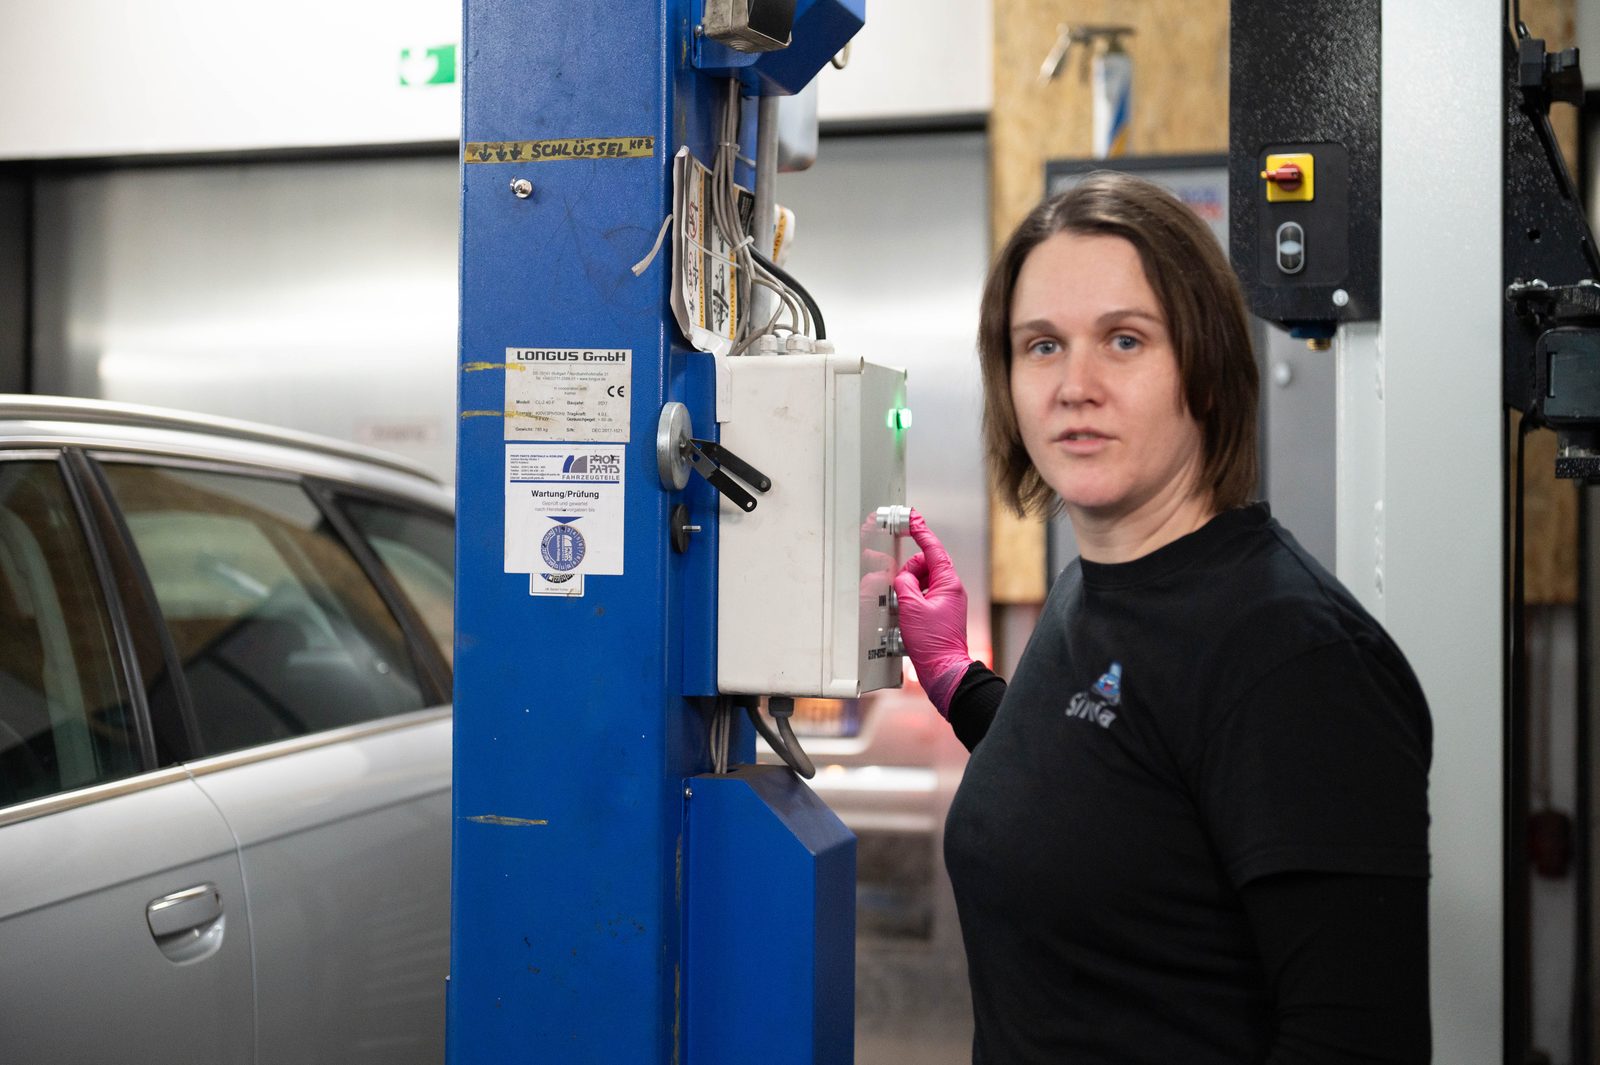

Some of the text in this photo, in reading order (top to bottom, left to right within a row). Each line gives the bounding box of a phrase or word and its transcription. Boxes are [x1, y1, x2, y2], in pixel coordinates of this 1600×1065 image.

[531, 140, 628, 159] SCHLÜSSEL
[516, 350, 626, 362] LONGUS GmbH
[589, 454, 620, 464] PROFI
[589, 465, 620, 474] PARTS
[531, 489, 600, 499] Wartung/Prüfung
